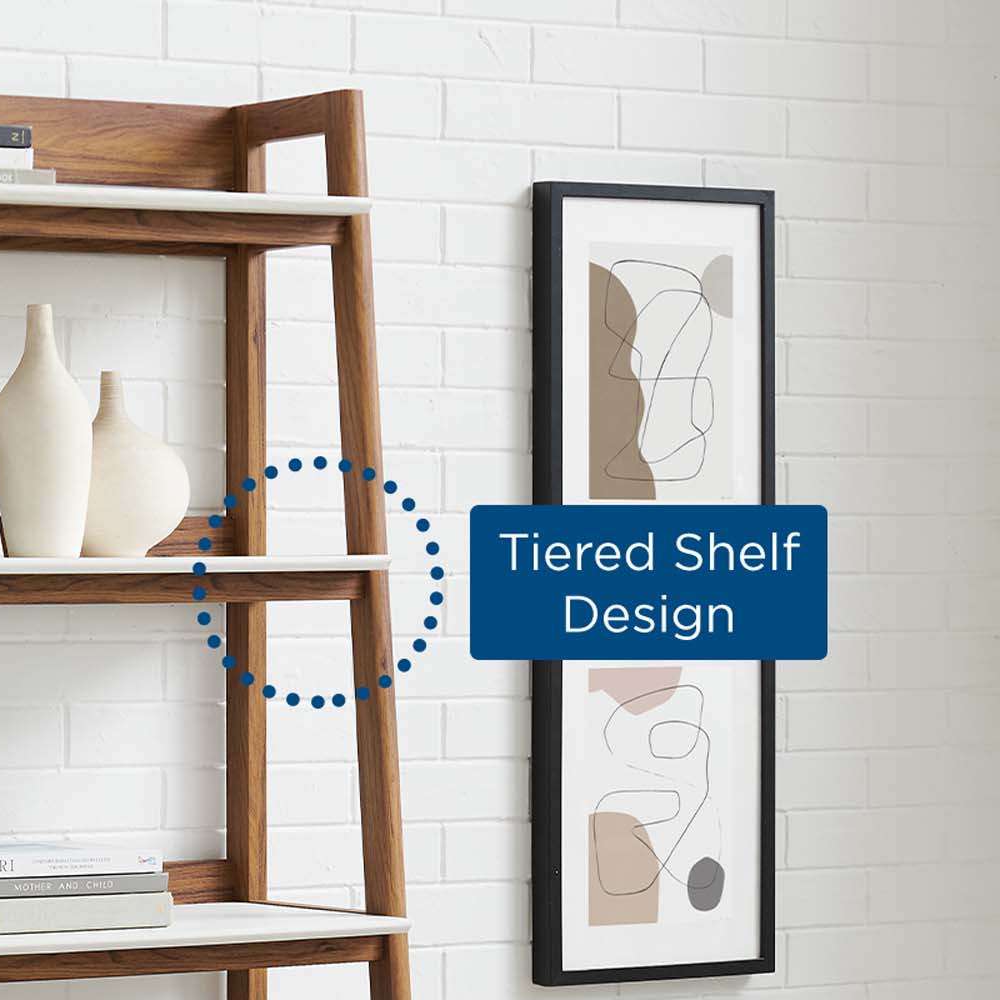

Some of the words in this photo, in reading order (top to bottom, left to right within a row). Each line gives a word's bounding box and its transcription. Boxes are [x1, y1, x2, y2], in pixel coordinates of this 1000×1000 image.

[14, 882, 52, 892] MOTHER
[58, 881, 79, 890] AND
[86, 880, 114, 890] CHILD
